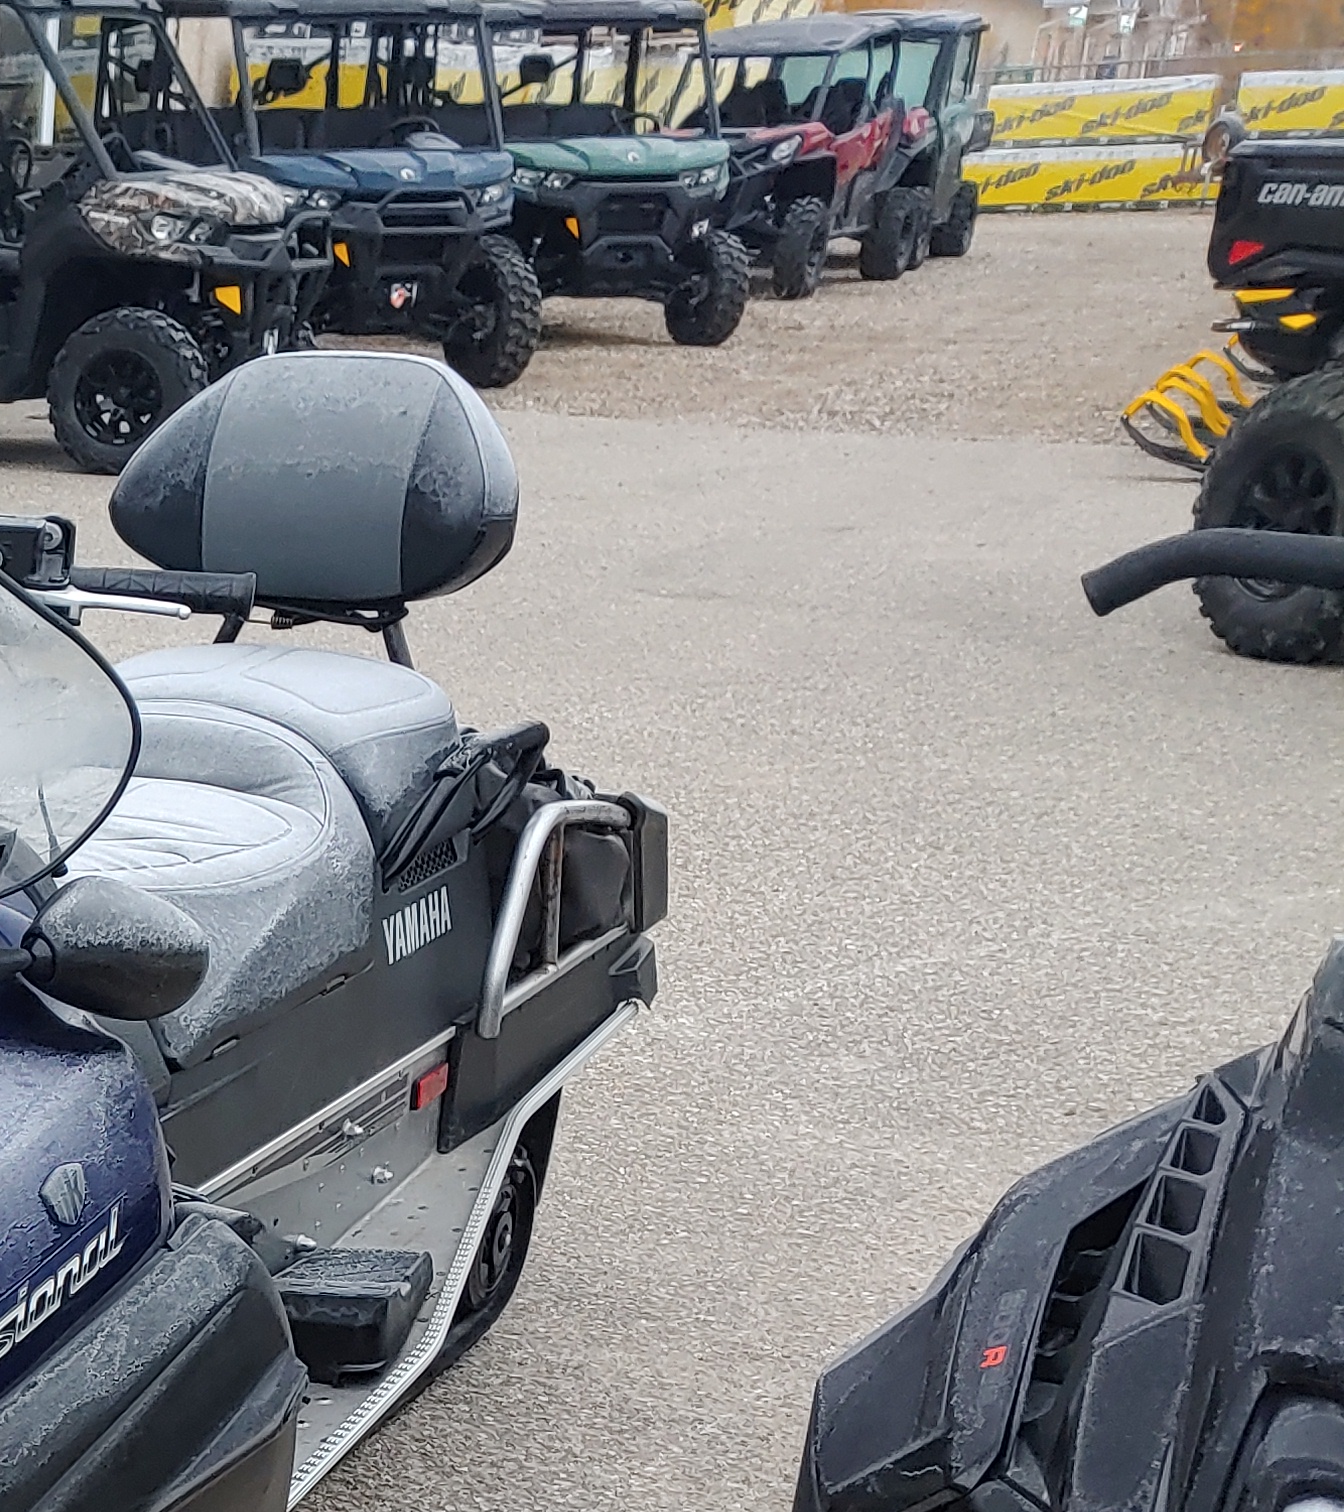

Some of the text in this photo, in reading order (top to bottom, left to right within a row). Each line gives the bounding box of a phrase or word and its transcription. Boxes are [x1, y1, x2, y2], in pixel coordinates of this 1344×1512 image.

[1081, 92, 1174, 133] ski-doo
[1044, 159, 1137, 201] ski-doo
[382, 885, 452, 965] YAMAHA
